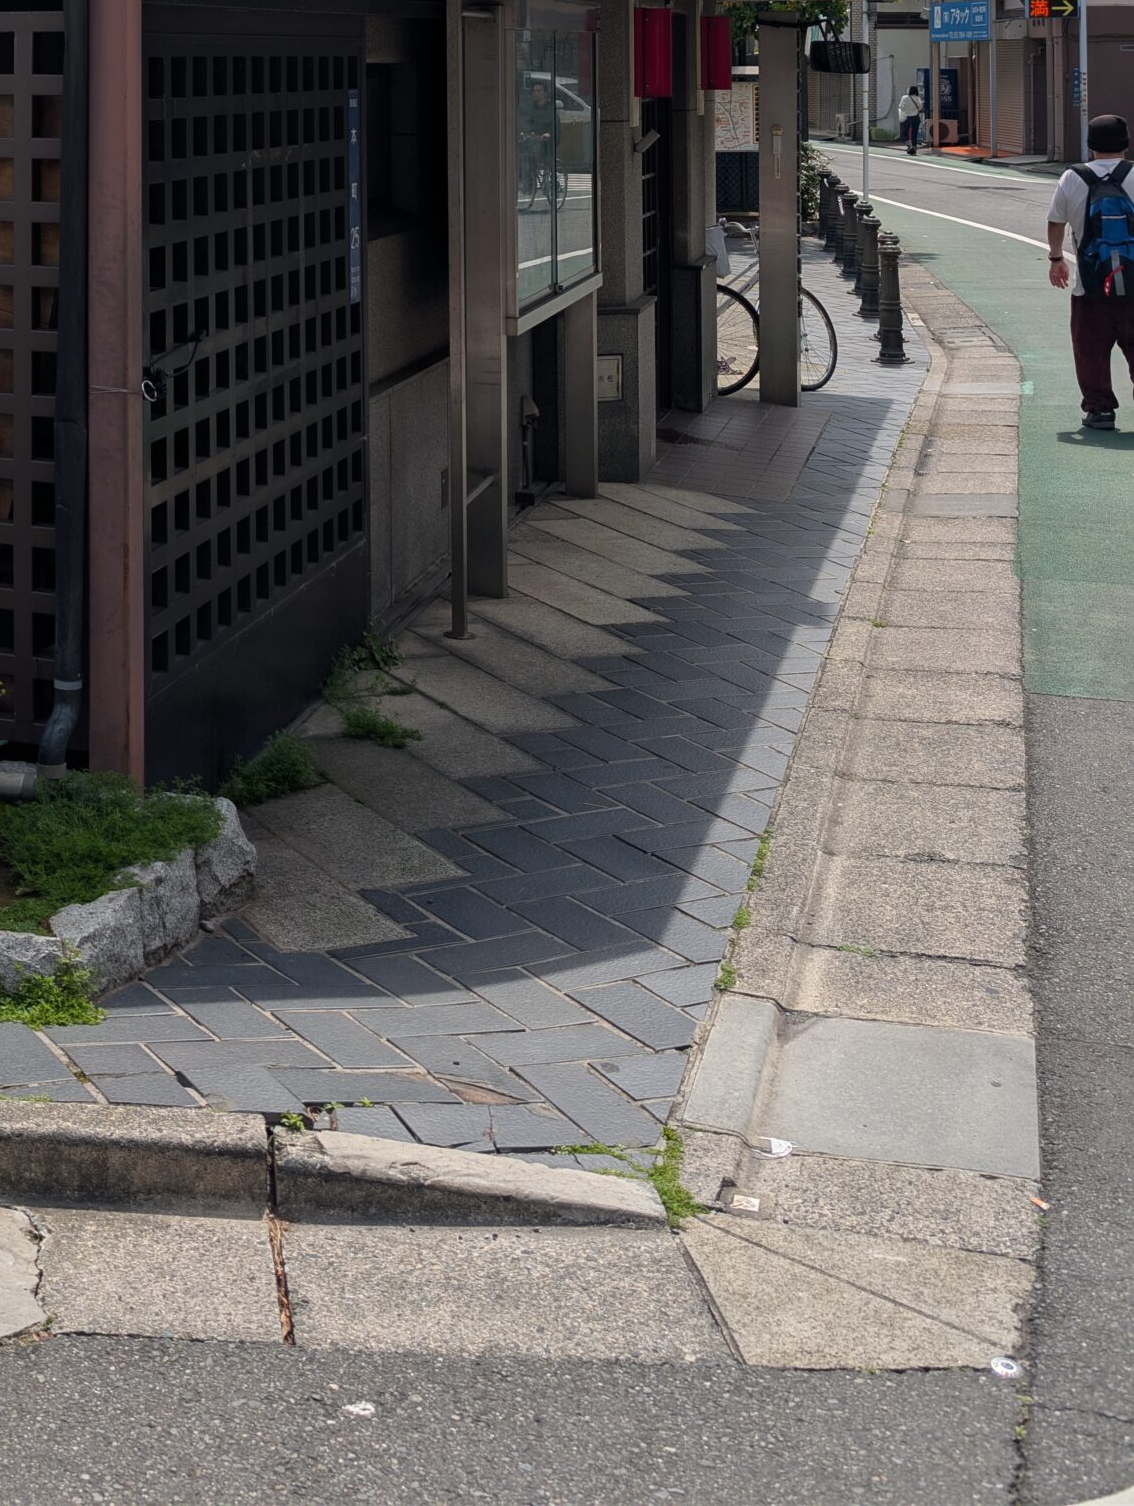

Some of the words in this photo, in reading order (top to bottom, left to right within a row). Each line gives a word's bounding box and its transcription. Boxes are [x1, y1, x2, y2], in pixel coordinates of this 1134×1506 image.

[950, 7, 969, 25] アタック
[1030, 0, 1049, 17] 満
[350, 226, 360, 249] 25
